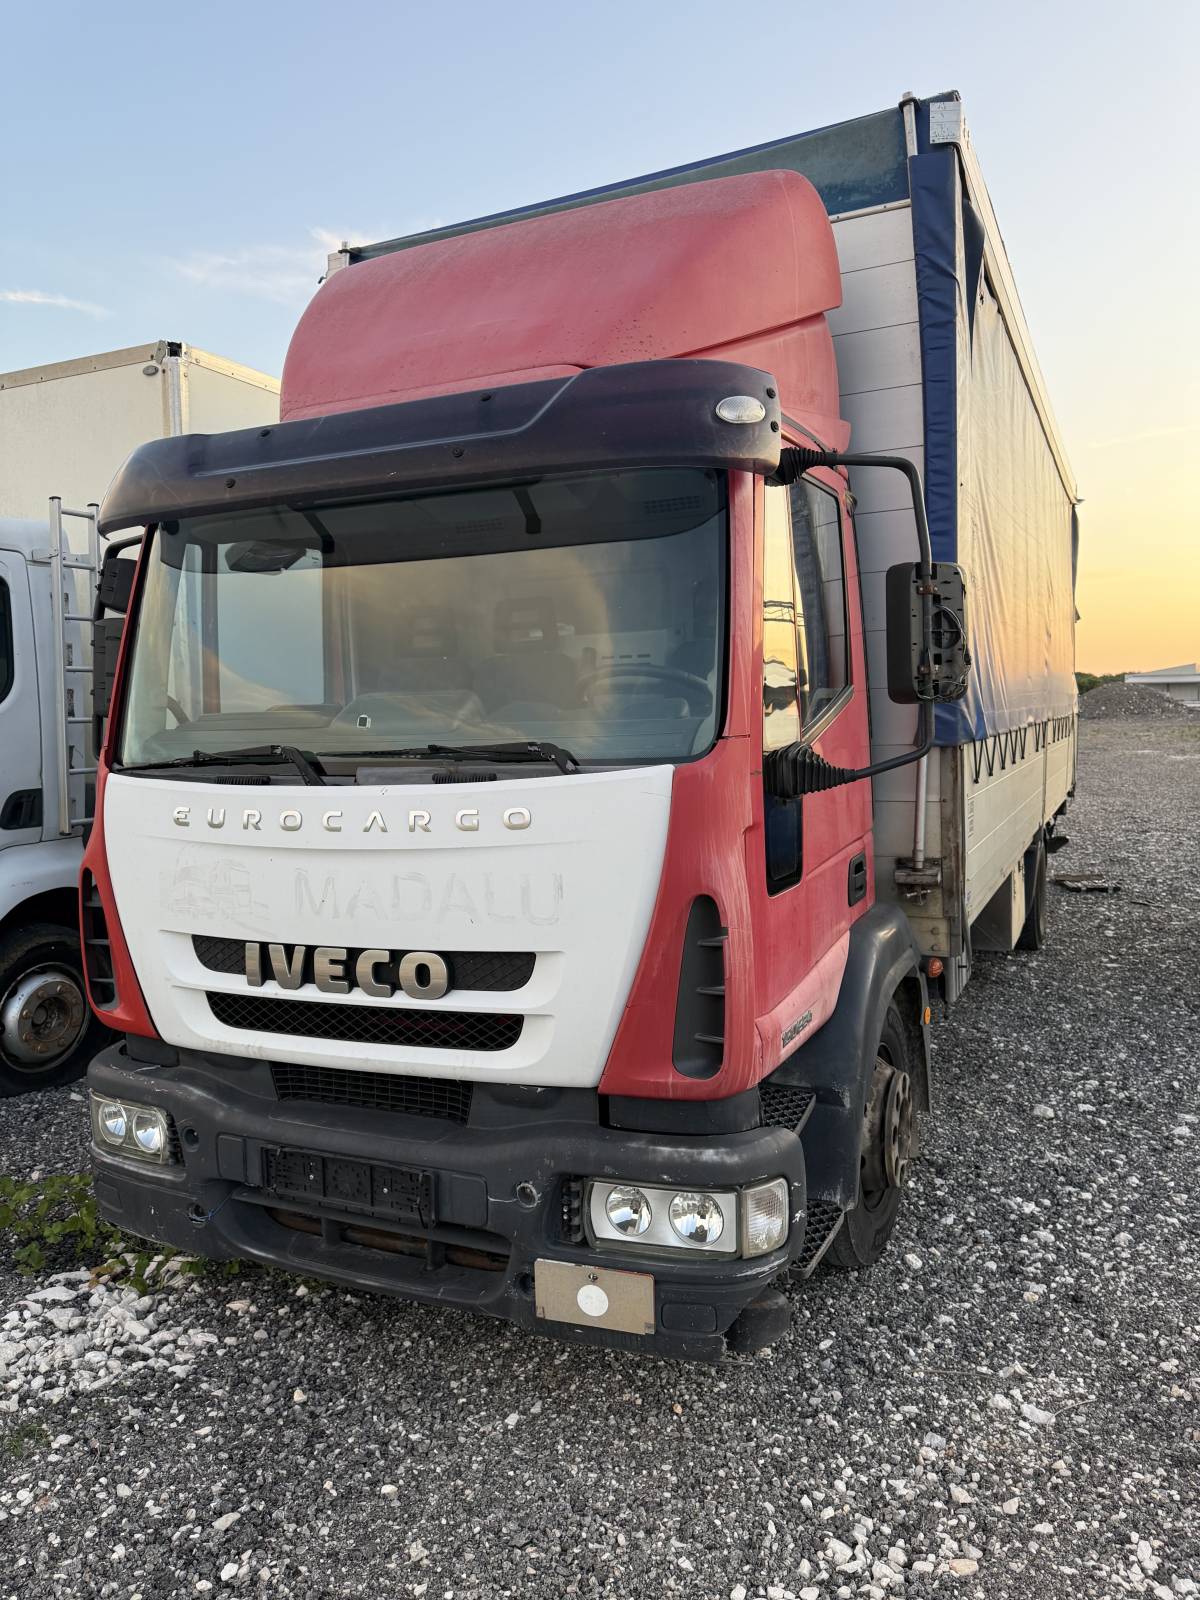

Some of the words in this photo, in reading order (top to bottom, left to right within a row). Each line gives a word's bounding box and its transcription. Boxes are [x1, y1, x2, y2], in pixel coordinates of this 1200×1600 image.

[172, 806, 532, 832] EUROCARGO
[294, 867, 564, 925] MADALU
[245, 942, 449, 1000] IVECO
